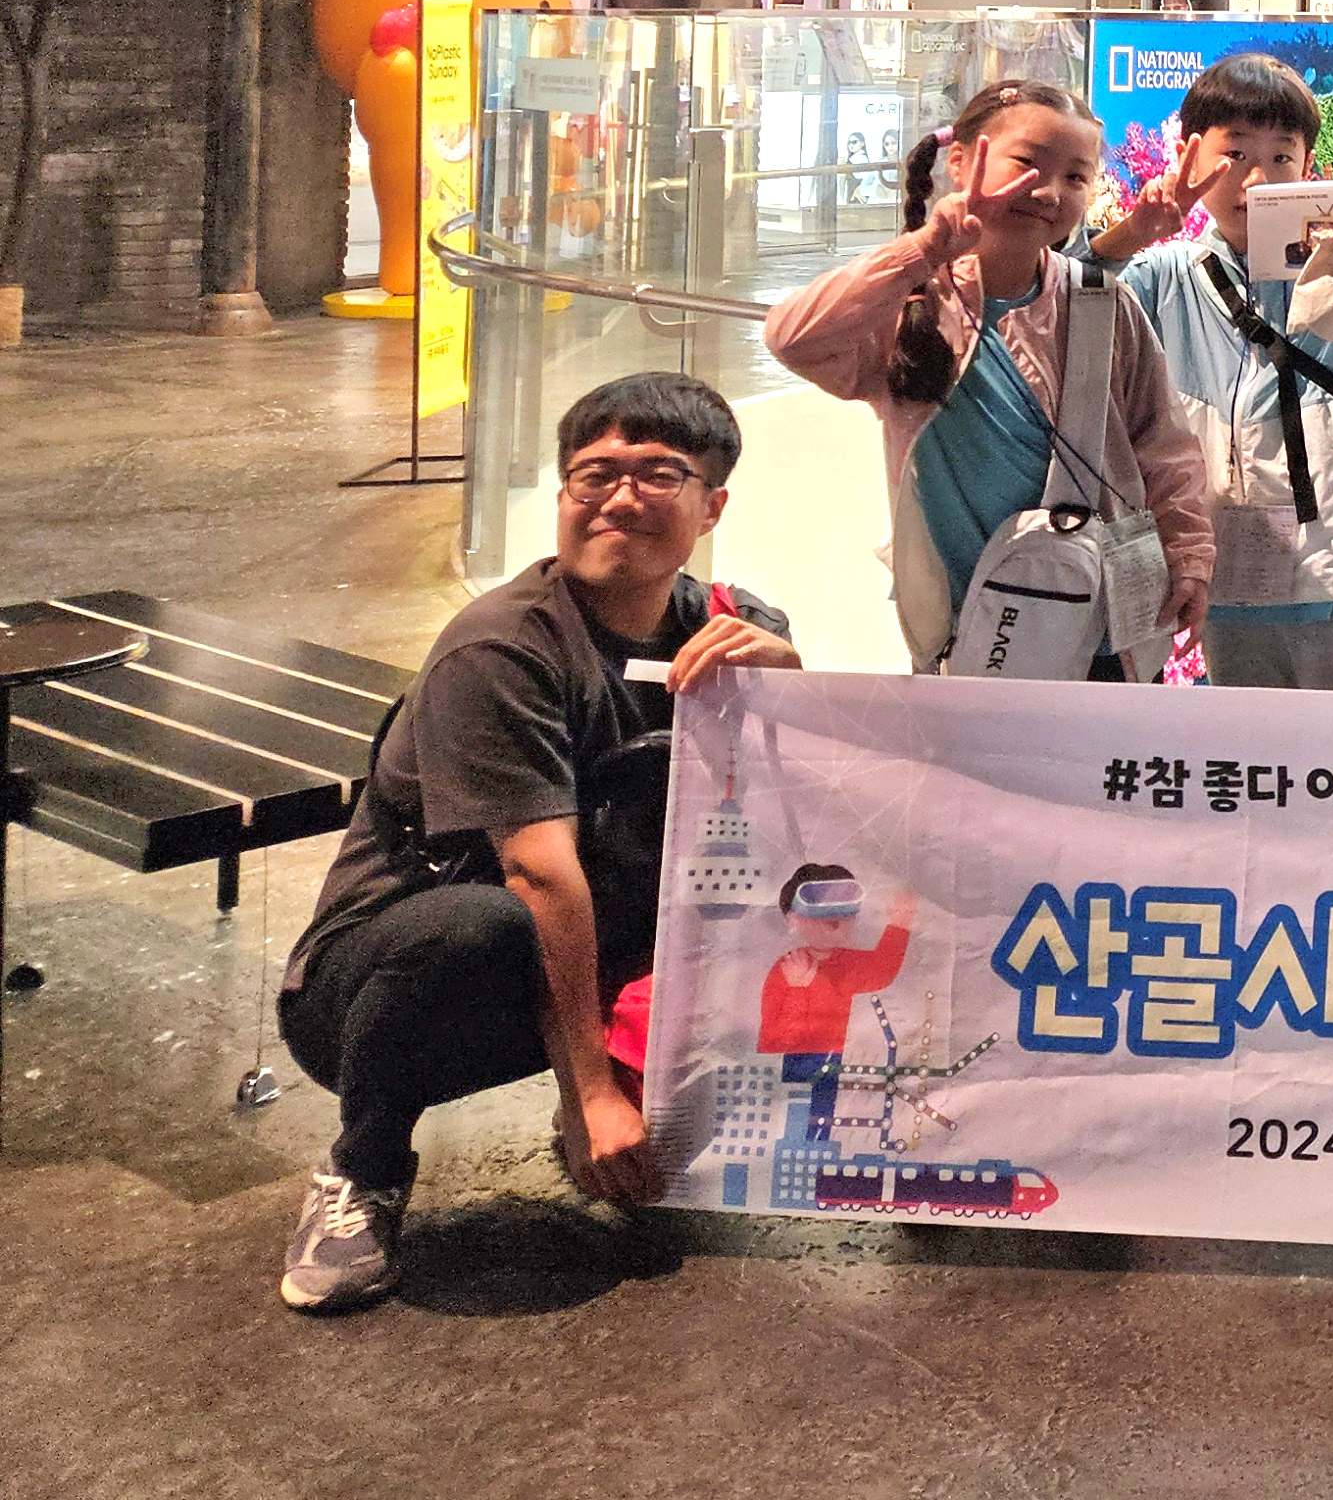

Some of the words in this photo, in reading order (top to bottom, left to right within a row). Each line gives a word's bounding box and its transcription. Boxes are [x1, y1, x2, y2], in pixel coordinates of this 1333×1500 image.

[1137, 51, 1204, 70] NATIONAL
[1136, 70, 1201, 89] GEOGRAP
[866, 103, 897, 114] CAR
[986, 606, 1020, 670] BLACK
[1103, 757, 1191, 809] #참
[1203, 761, 1294, 812] 좋다
